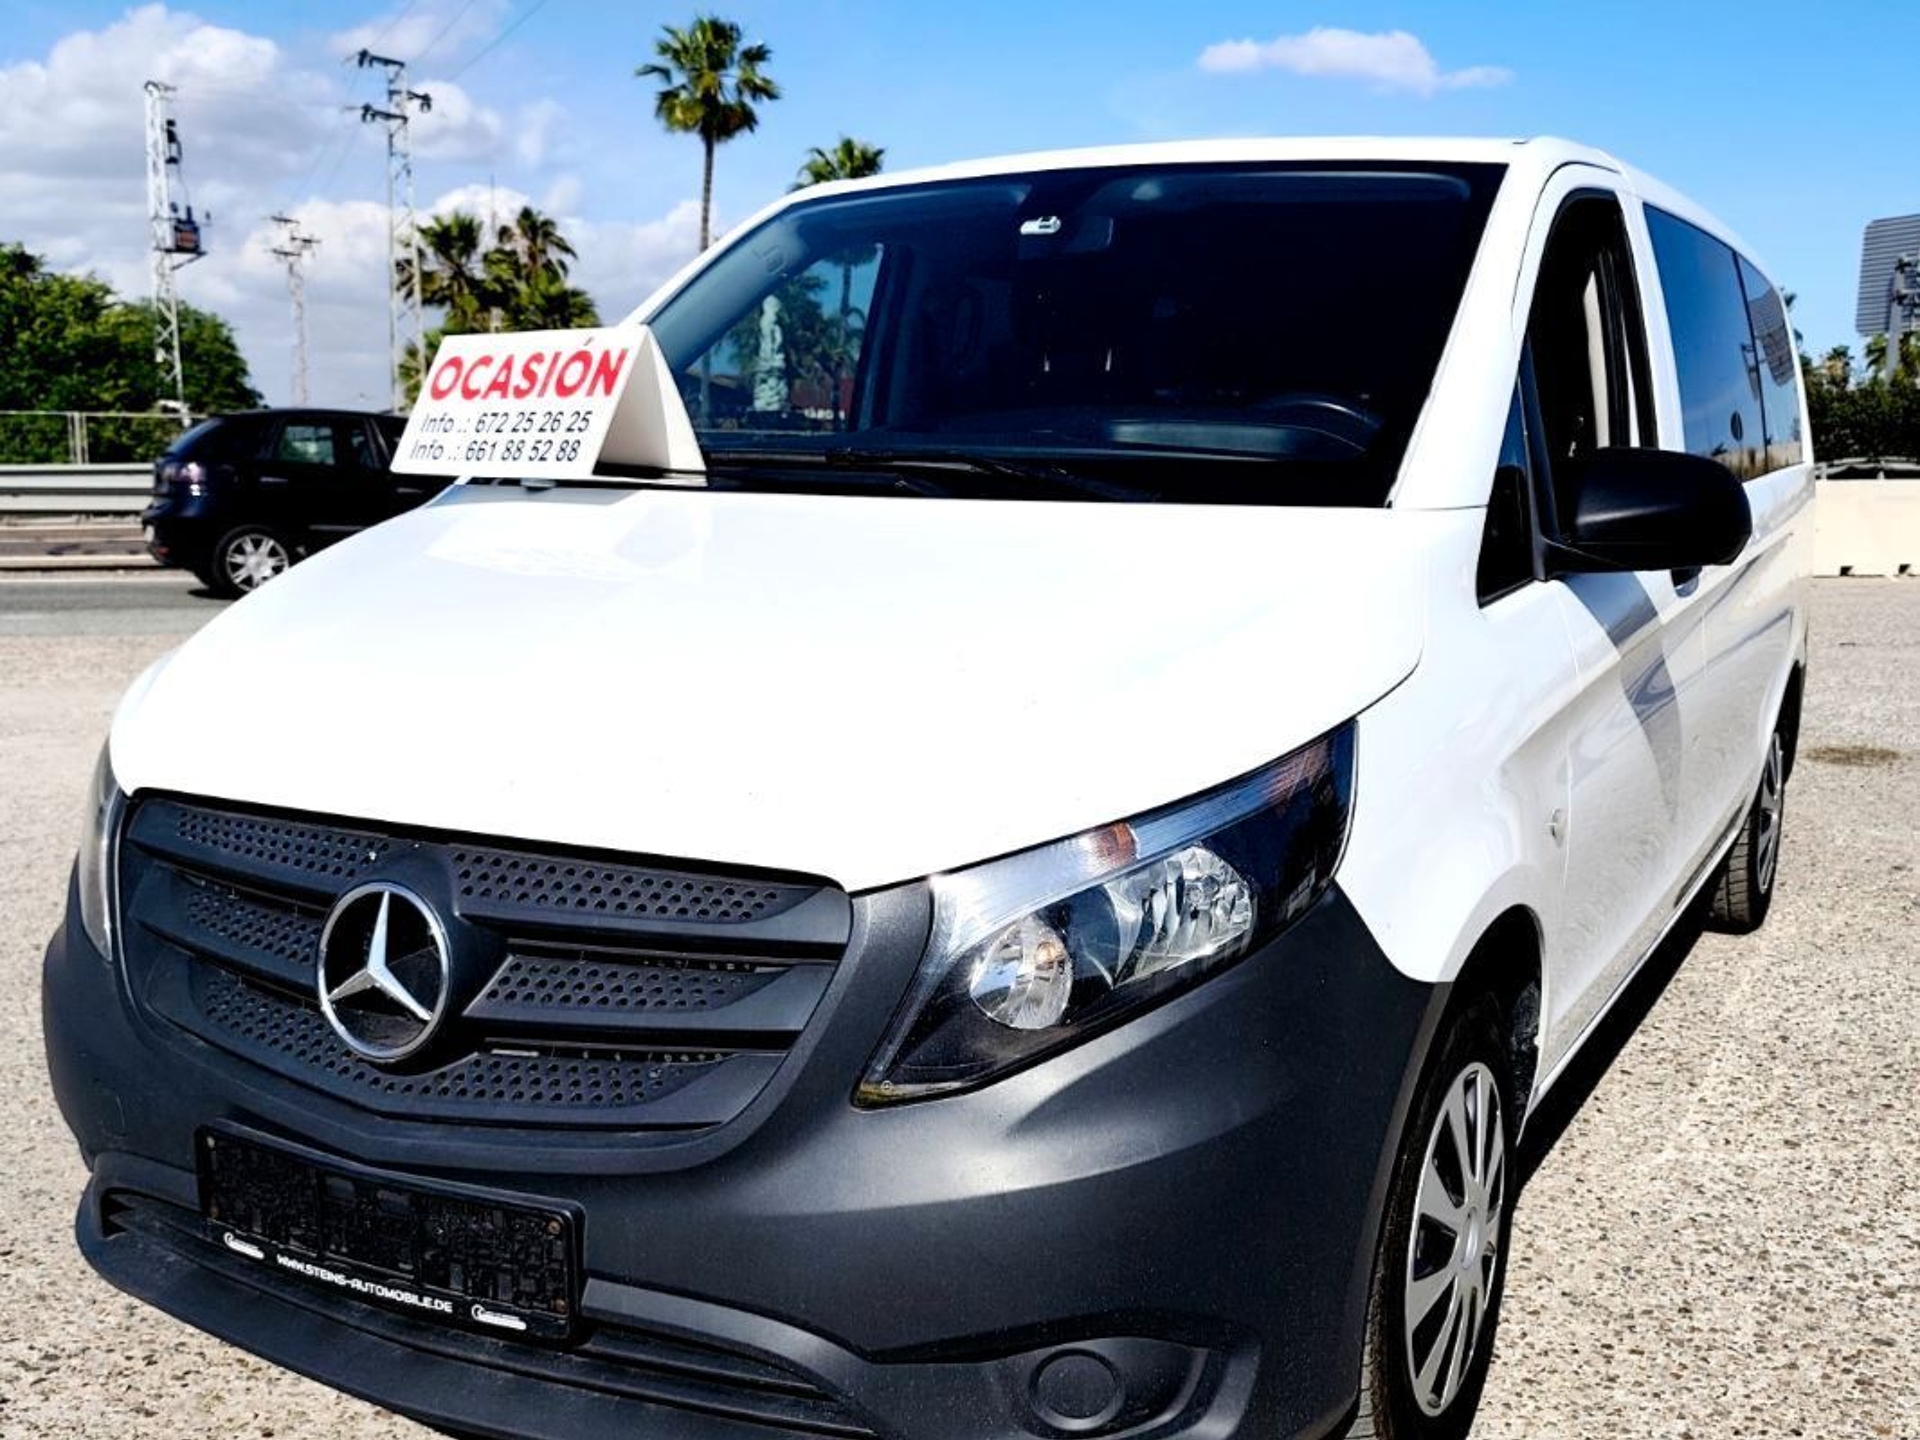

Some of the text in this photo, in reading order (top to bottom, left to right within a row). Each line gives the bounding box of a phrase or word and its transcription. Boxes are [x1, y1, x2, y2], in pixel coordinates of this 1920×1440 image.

[430, 337, 629, 401] OCASIÓN
[420, 411, 455, 433] Info
[475, 411, 509, 433] 672
[511, 411, 536, 433] 25
[538, 411, 564, 433] 26
[566, 410, 593, 432] 25
[410, 439, 444, 460] Info
[465, 440, 498, 461] 661
[501, 439, 526, 461] 88
[528, 439, 553, 461] 52
[556, 439, 581, 461] 88
